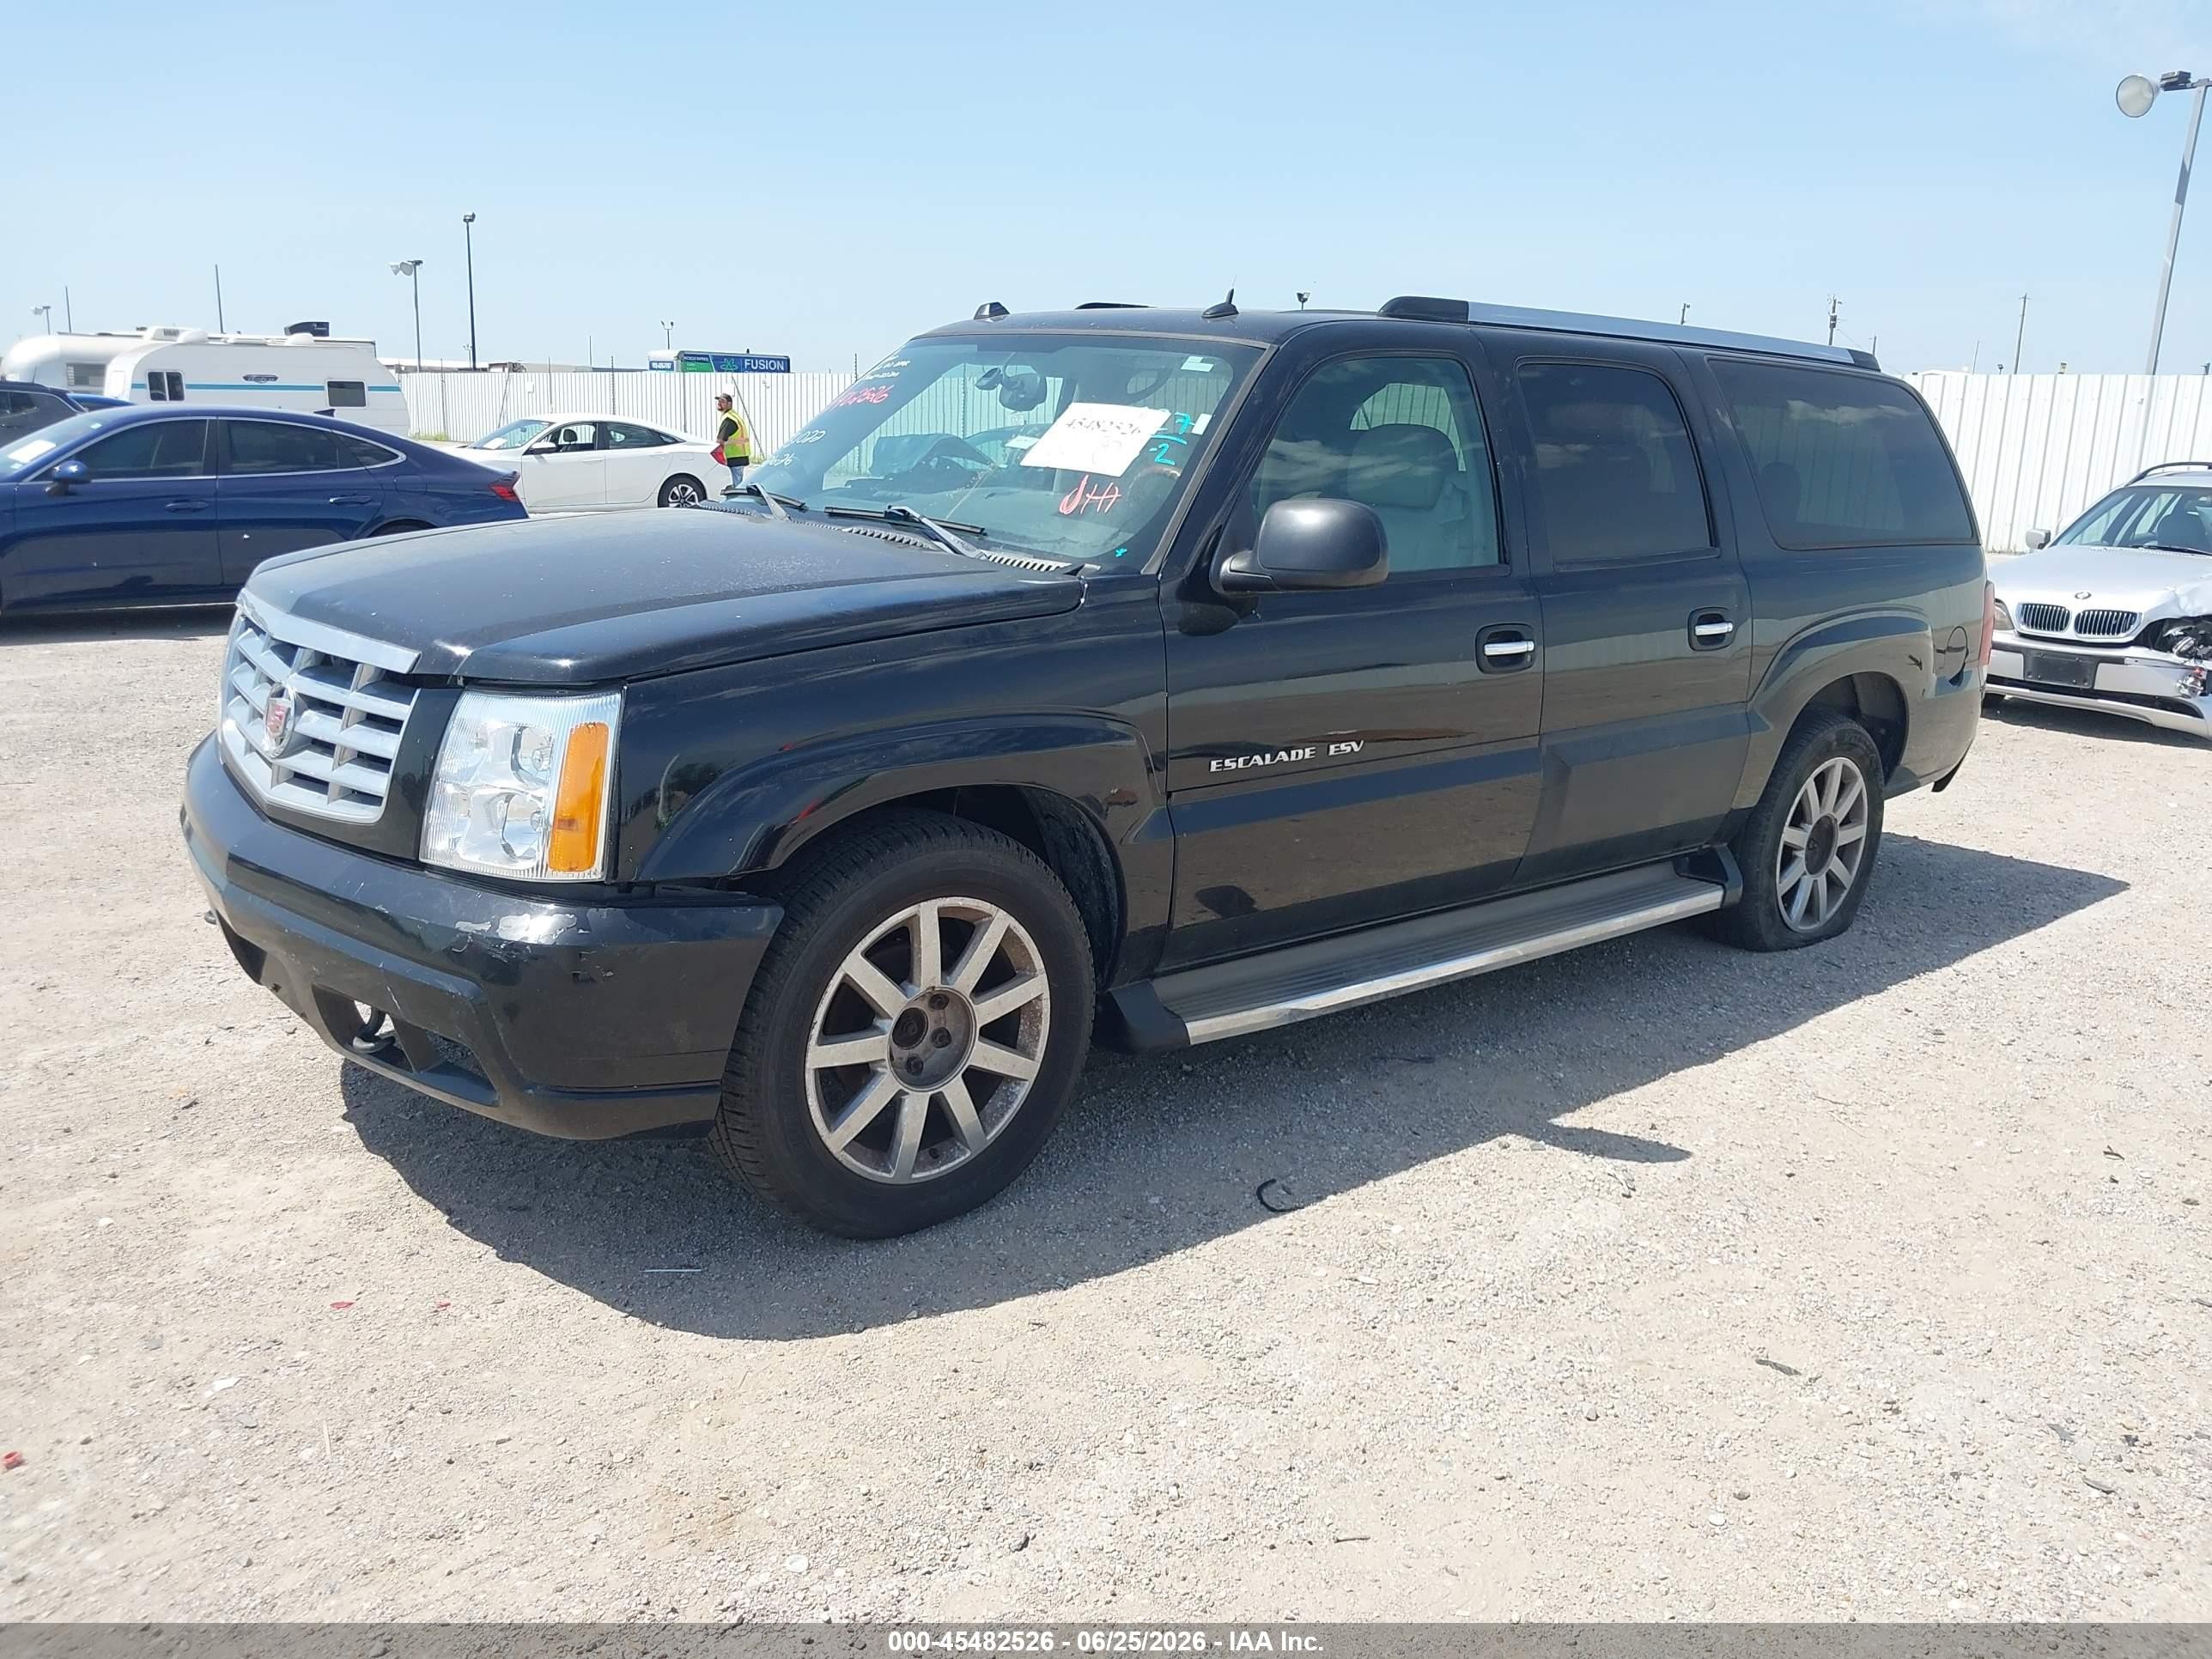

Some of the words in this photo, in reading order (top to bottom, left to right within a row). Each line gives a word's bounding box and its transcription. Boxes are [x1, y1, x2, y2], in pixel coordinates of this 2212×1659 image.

[744, 358, 784, 371] FUSION
[1210, 747, 1316, 772] ESCALADE
[1328, 740, 1364, 756] ESV
